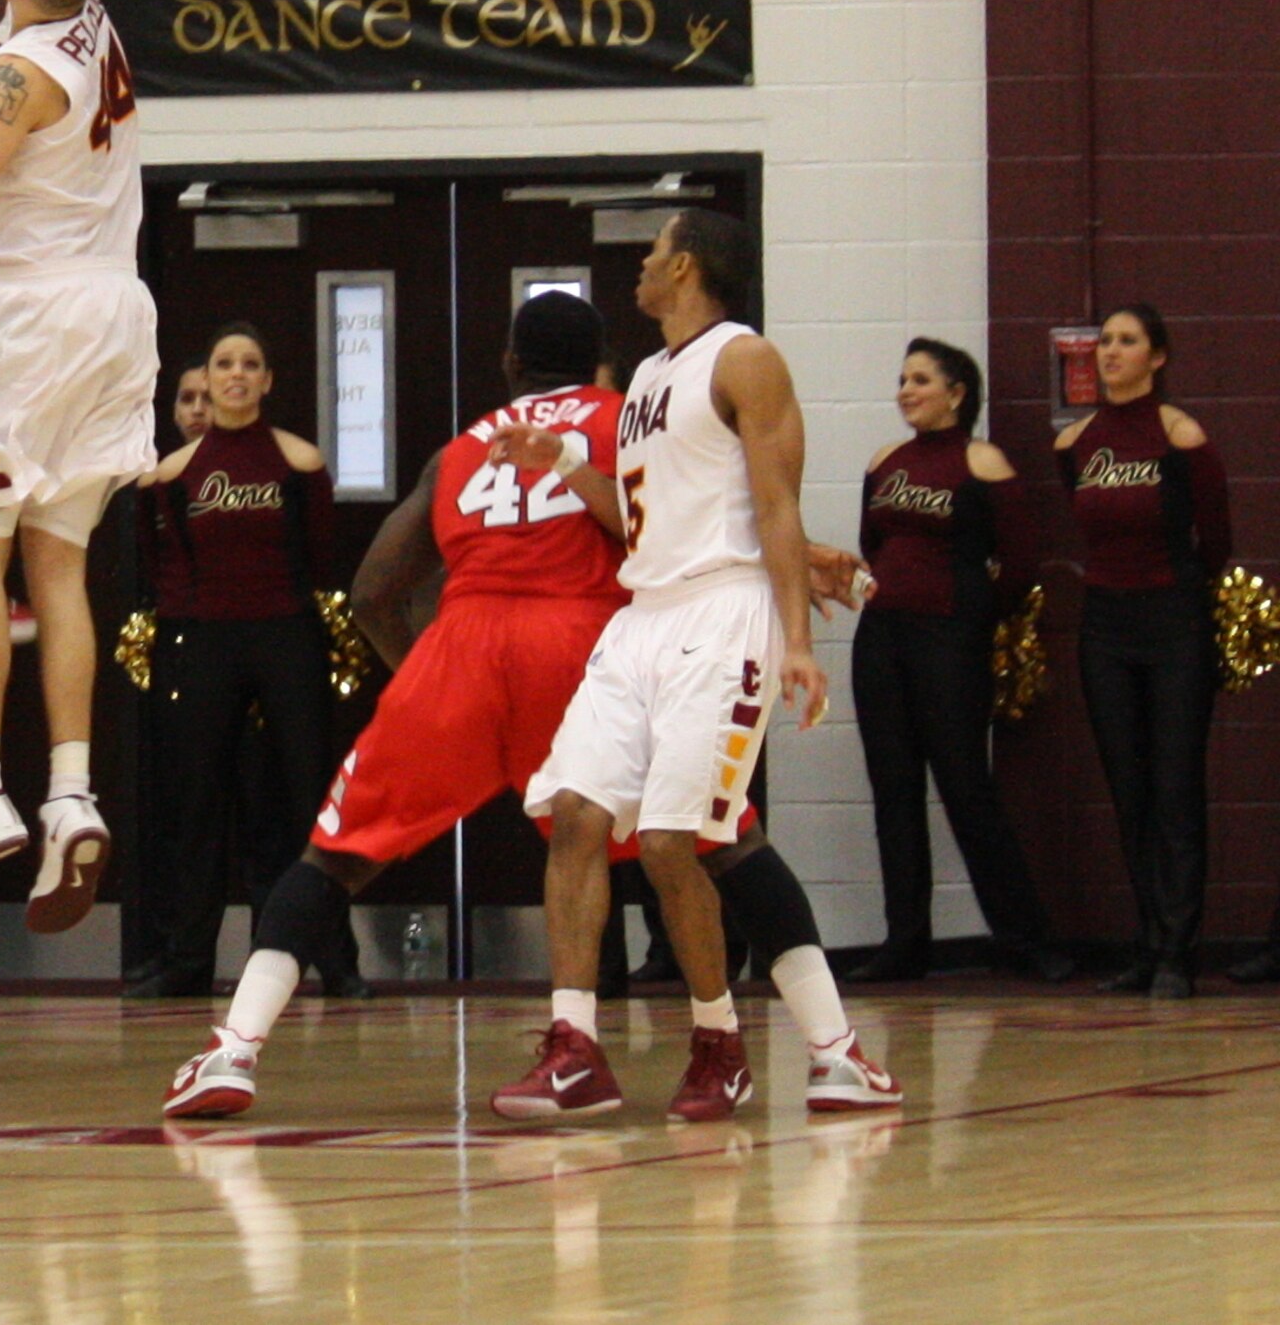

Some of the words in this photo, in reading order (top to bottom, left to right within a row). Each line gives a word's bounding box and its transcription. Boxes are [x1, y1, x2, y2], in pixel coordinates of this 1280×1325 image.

[467, 396, 602, 444] WATSON
[619, 385, 672, 450] ONA
[456, 429, 590, 528] 42
